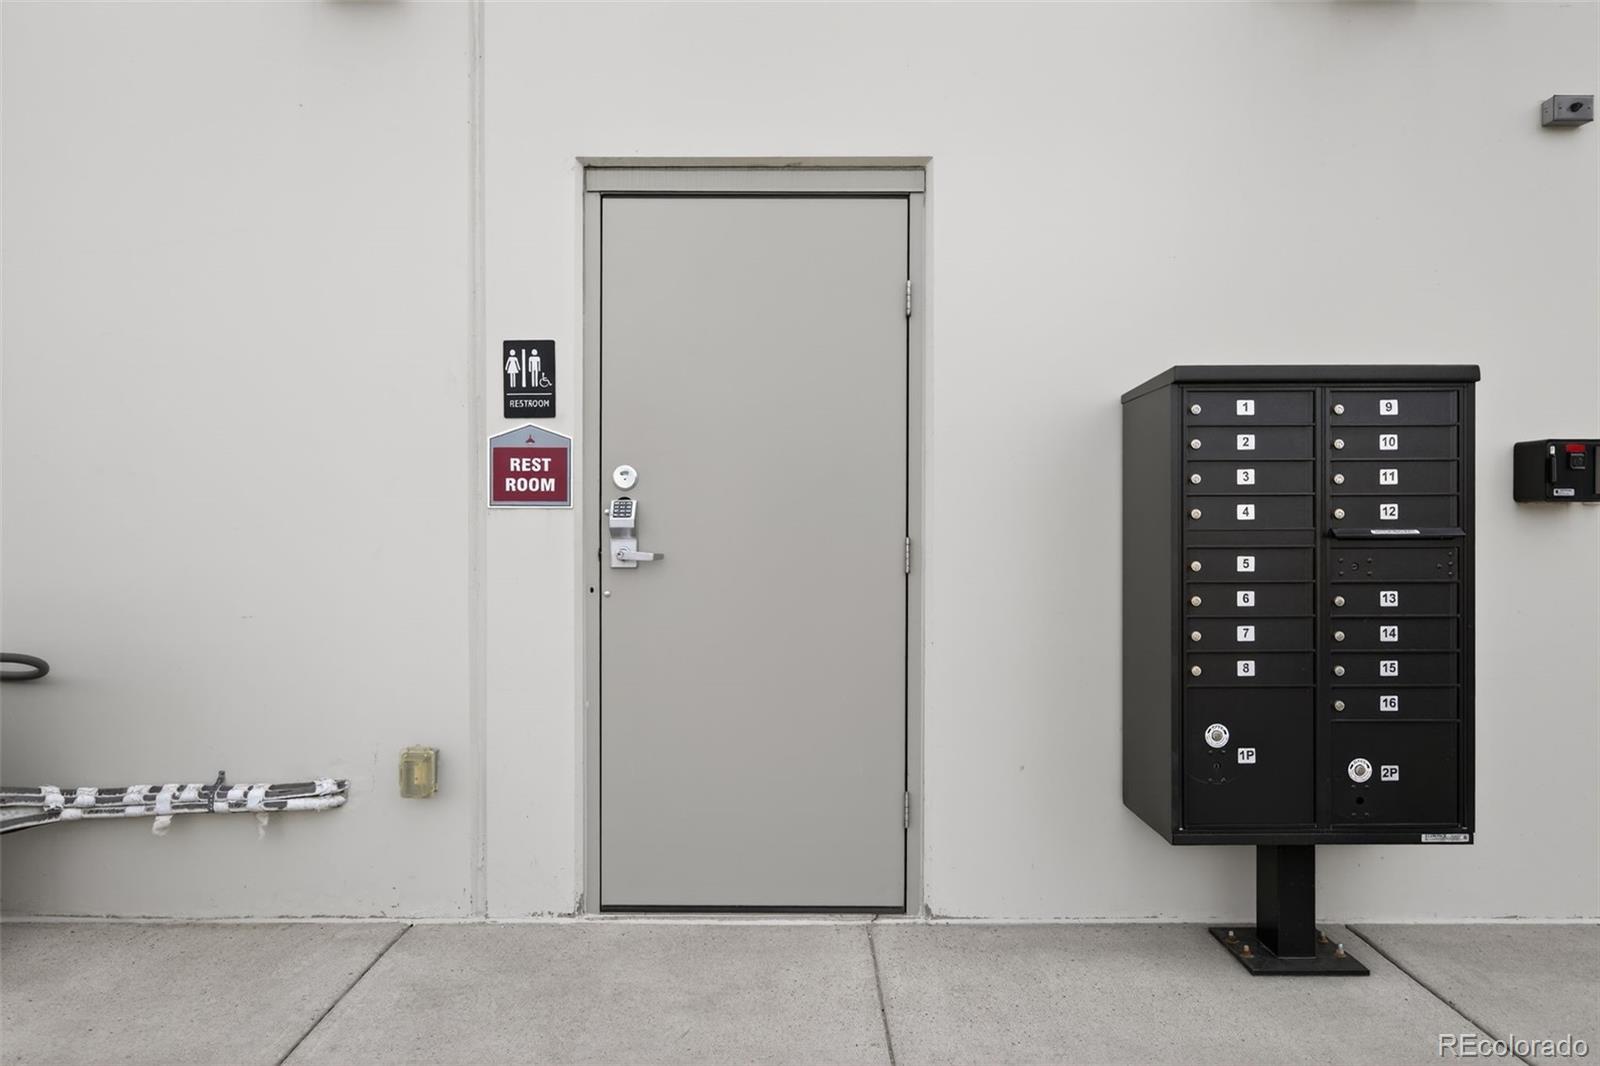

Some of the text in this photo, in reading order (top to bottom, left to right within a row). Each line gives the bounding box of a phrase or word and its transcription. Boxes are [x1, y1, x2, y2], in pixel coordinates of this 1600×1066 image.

[509, 399, 551, 408] RESTROOM
[1242, 402, 1249, 412] 1
[1385, 402, 1393, 412] 9
[1242, 436, 1249, 447] 2
[1382, 436, 1396, 447] 10
[509, 457, 552, 472] REST
[1242, 471, 1250, 482] 3
[1382, 471, 1395, 482] 11
[505, 478, 555, 492] ROOM
[1242, 506, 1250, 517] 4
[1382, 506, 1396, 517] 12
[1242, 558, 1250, 569] 5
[1242, 593, 1250, 604] 6
[1382, 593, 1397, 604] 13
[1242, 627, 1250, 638] 7
[1382, 627, 1397, 639] 14
[1242, 662, 1250, 673] 8
[1382, 662, 1397, 673] 15
[1382, 697, 1397, 709] 16
[1239, 750, 1255, 761] 1P
[1382, 767, 1398, 779] 2P
